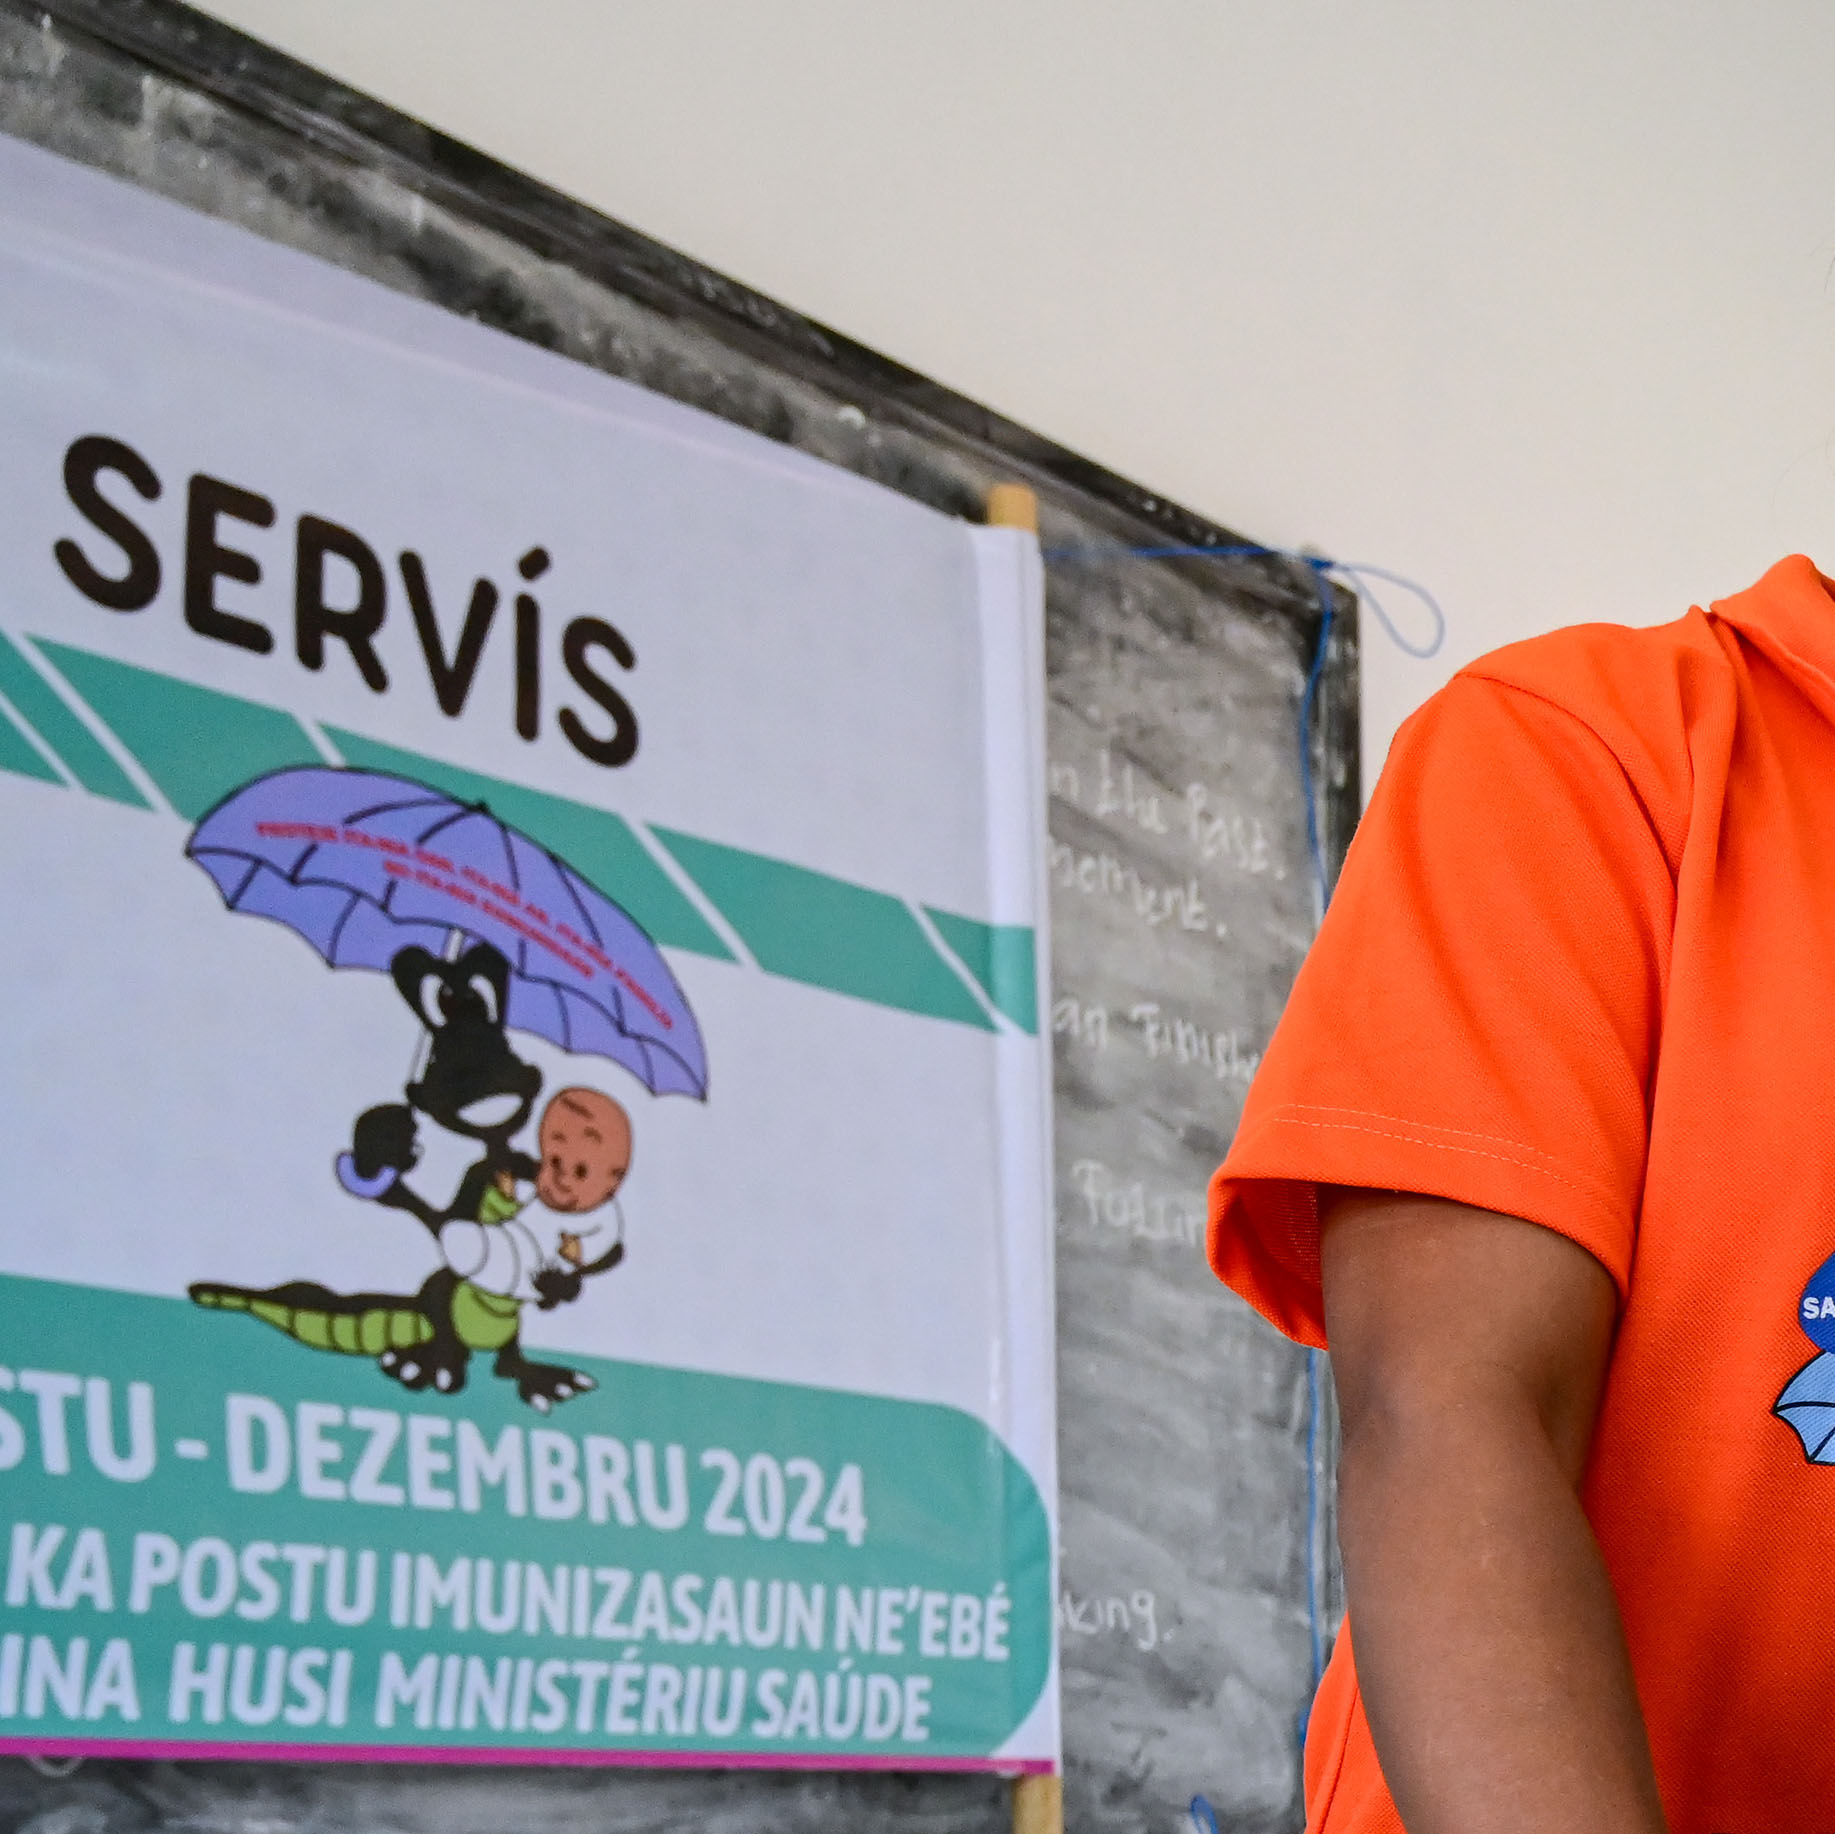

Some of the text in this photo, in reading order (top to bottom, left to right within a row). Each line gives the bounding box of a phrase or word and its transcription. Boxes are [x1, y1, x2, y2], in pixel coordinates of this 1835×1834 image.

[54, 435, 640, 768] SERVÍS
[226, 1393, 690, 1532] DEZEMBRU
[699, 1446, 870, 1548] 2024
[7, 1522, 114, 1612] KA
[129, 1531, 378, 1628] POSTU
[390, 1551, 829, 1653] IMUNIZASAUN
[169, 1642, 353, 1727] HUSI
[375, 1645, 749, 1738] MINISTÉRIU
[750, 1656, 934, 1743] SAÚDE
